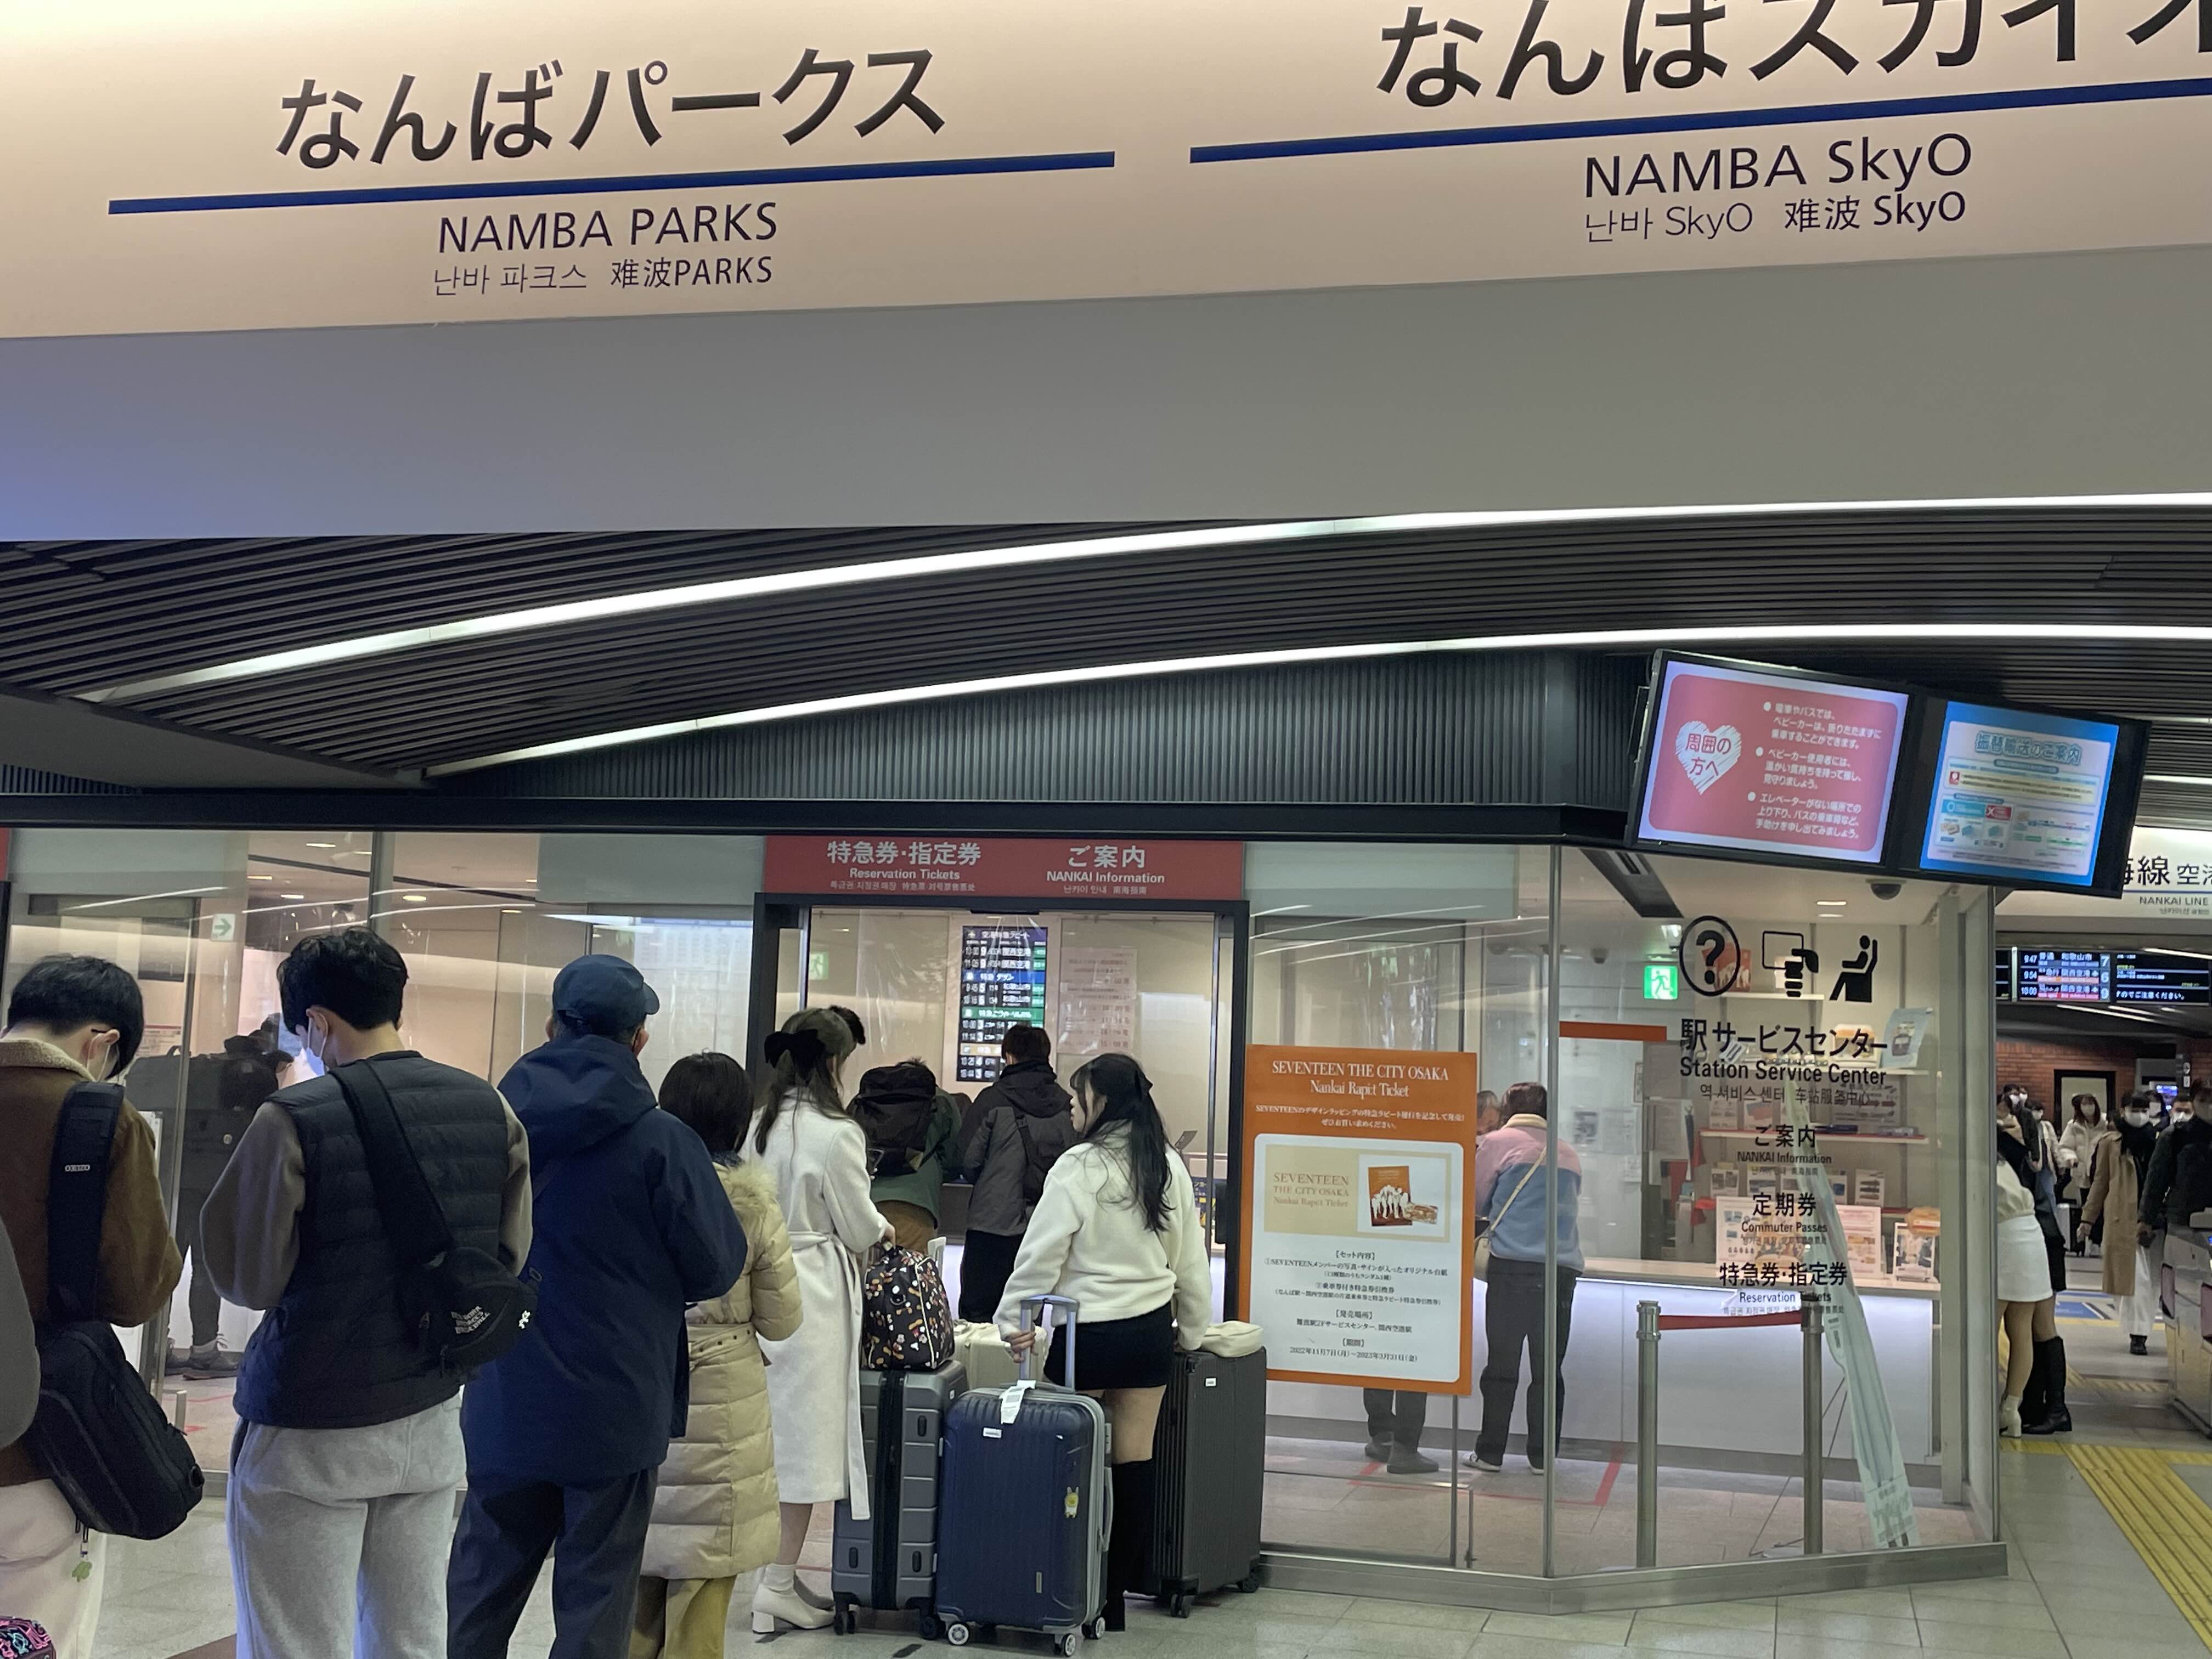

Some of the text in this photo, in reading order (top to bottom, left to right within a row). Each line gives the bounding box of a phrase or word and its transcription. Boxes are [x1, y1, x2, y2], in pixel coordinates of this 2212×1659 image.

[275, 48, 946, 169] なんばパークス
[1585, 133, 1972, 198] NAMBA SkyO
[1585, 191, 1966, 242] 난바 SkyO 难波 SkyO
[439, 202, 777, 253] NAMBA PARKS
[434, 256, 773, 296] 난바 파크스 难波PARKS
[1685, 733, 1731, 754] 周囲の
[1689, 757, 1719, 776] 方へ
[1068, 845, 1146, 869] ご案内
[850, 867, 961, 880] Reservation Tickets
[1046, 870, 1165, 884] NANKAI Information
[2139, 896, 2208, 906] NANKAI LINE
[2101, 955, 2109, 967] 7
[2101, 972, 2109, 984] 6
[1680, 1018, 1888, 1058] 駅サービスセンター
[1272, 1060, 1449, 1081] SEVENTEEN THE CITY OSAKA
[1679, 1057, 1887, 1086] Station Service Center
[1310, 1079, 1345, 1094] Nankai
[1378, 1082, 1409, 1097] Ticket
[1755, 1123, 1816, 1149] ご案内
[1737, 1152, 1832, 1164] NANKAI Information
[1273, 1172, 1350, 1186] SEVENTEEN
[1273, 1185, 1349, 1197] THE CITY OSAKA
[1752, 1192, 1816, 1217] 定期券
[1741, 1221, 1827, 1233] Commuter Passes
[1739, 1292, 1796, 1303] Reservation
